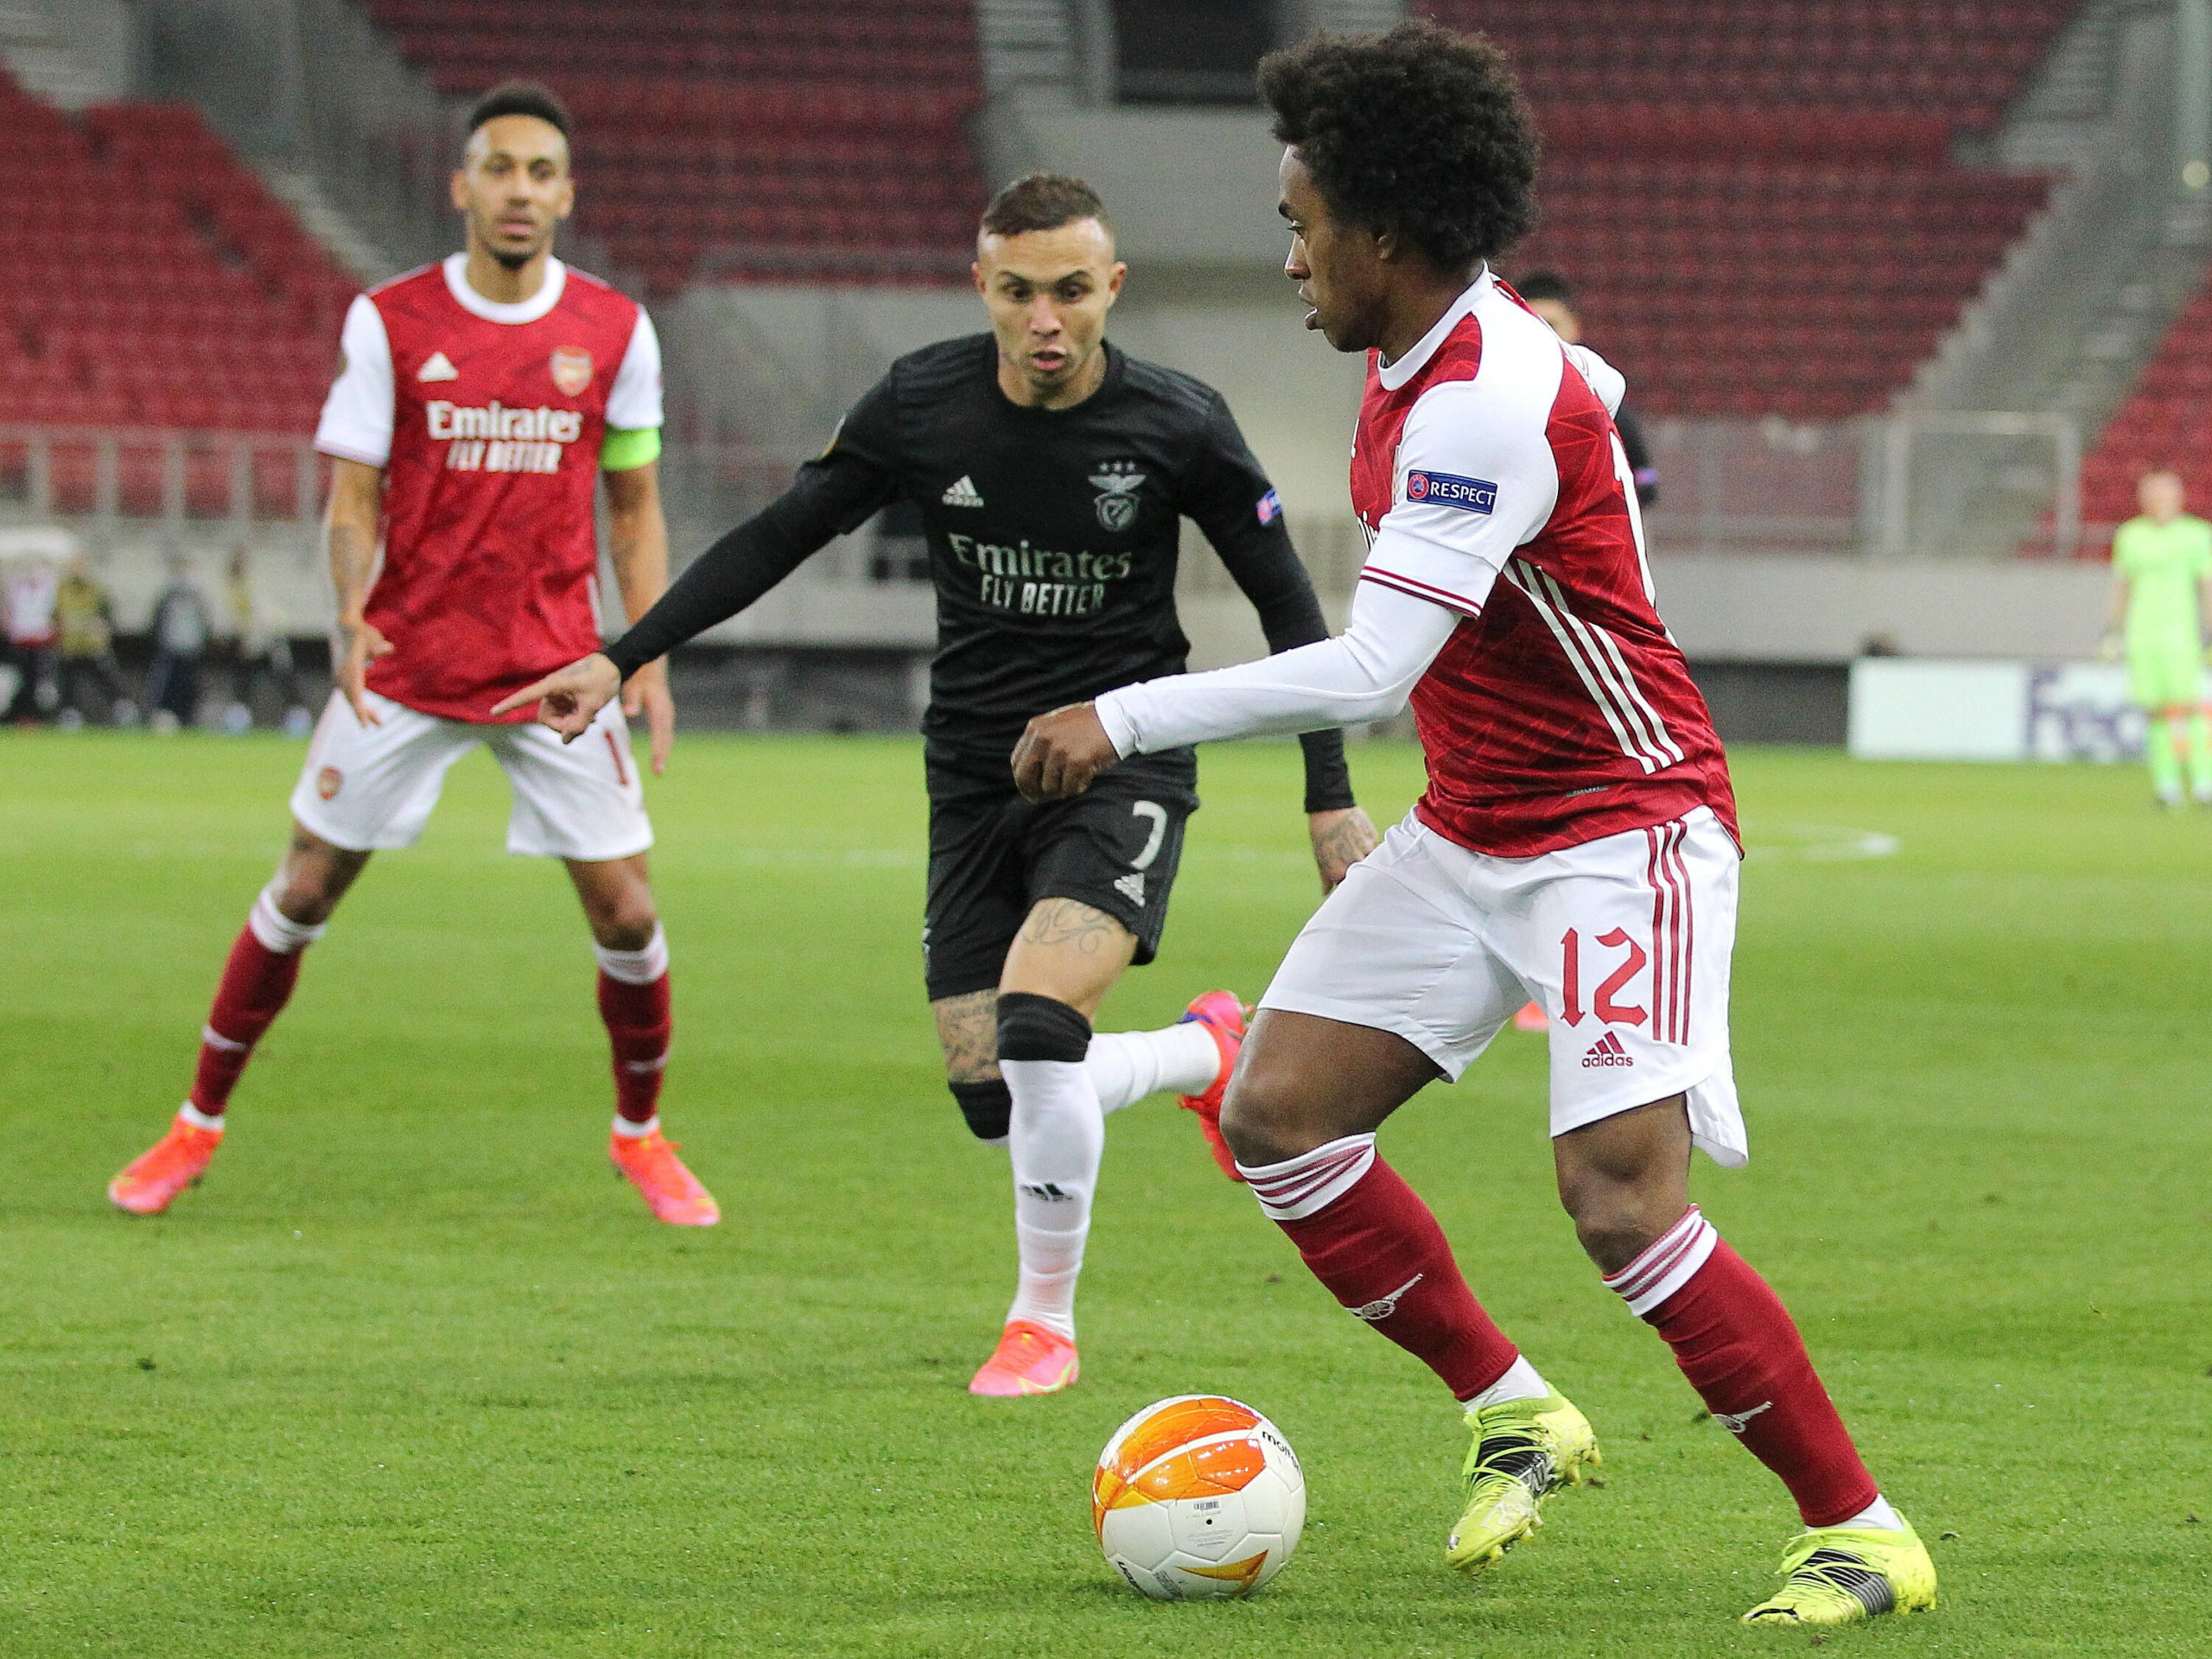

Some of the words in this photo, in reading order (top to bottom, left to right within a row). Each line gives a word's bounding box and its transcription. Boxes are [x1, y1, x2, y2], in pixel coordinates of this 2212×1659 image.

[427, 400, 583, 443] Emirates
[1430, 481, 1496, 505] RESPECT
[950, 532, 1132, 580] Emirates
[981, 575, 1014, 609] FLY
[1020, 582, 1104, 615] BETTER
[1130, 800, 1168, 871] 7
[1560, 926, 1649, 1028] 12
[1581, 1052, 1634, 1068] adidas
